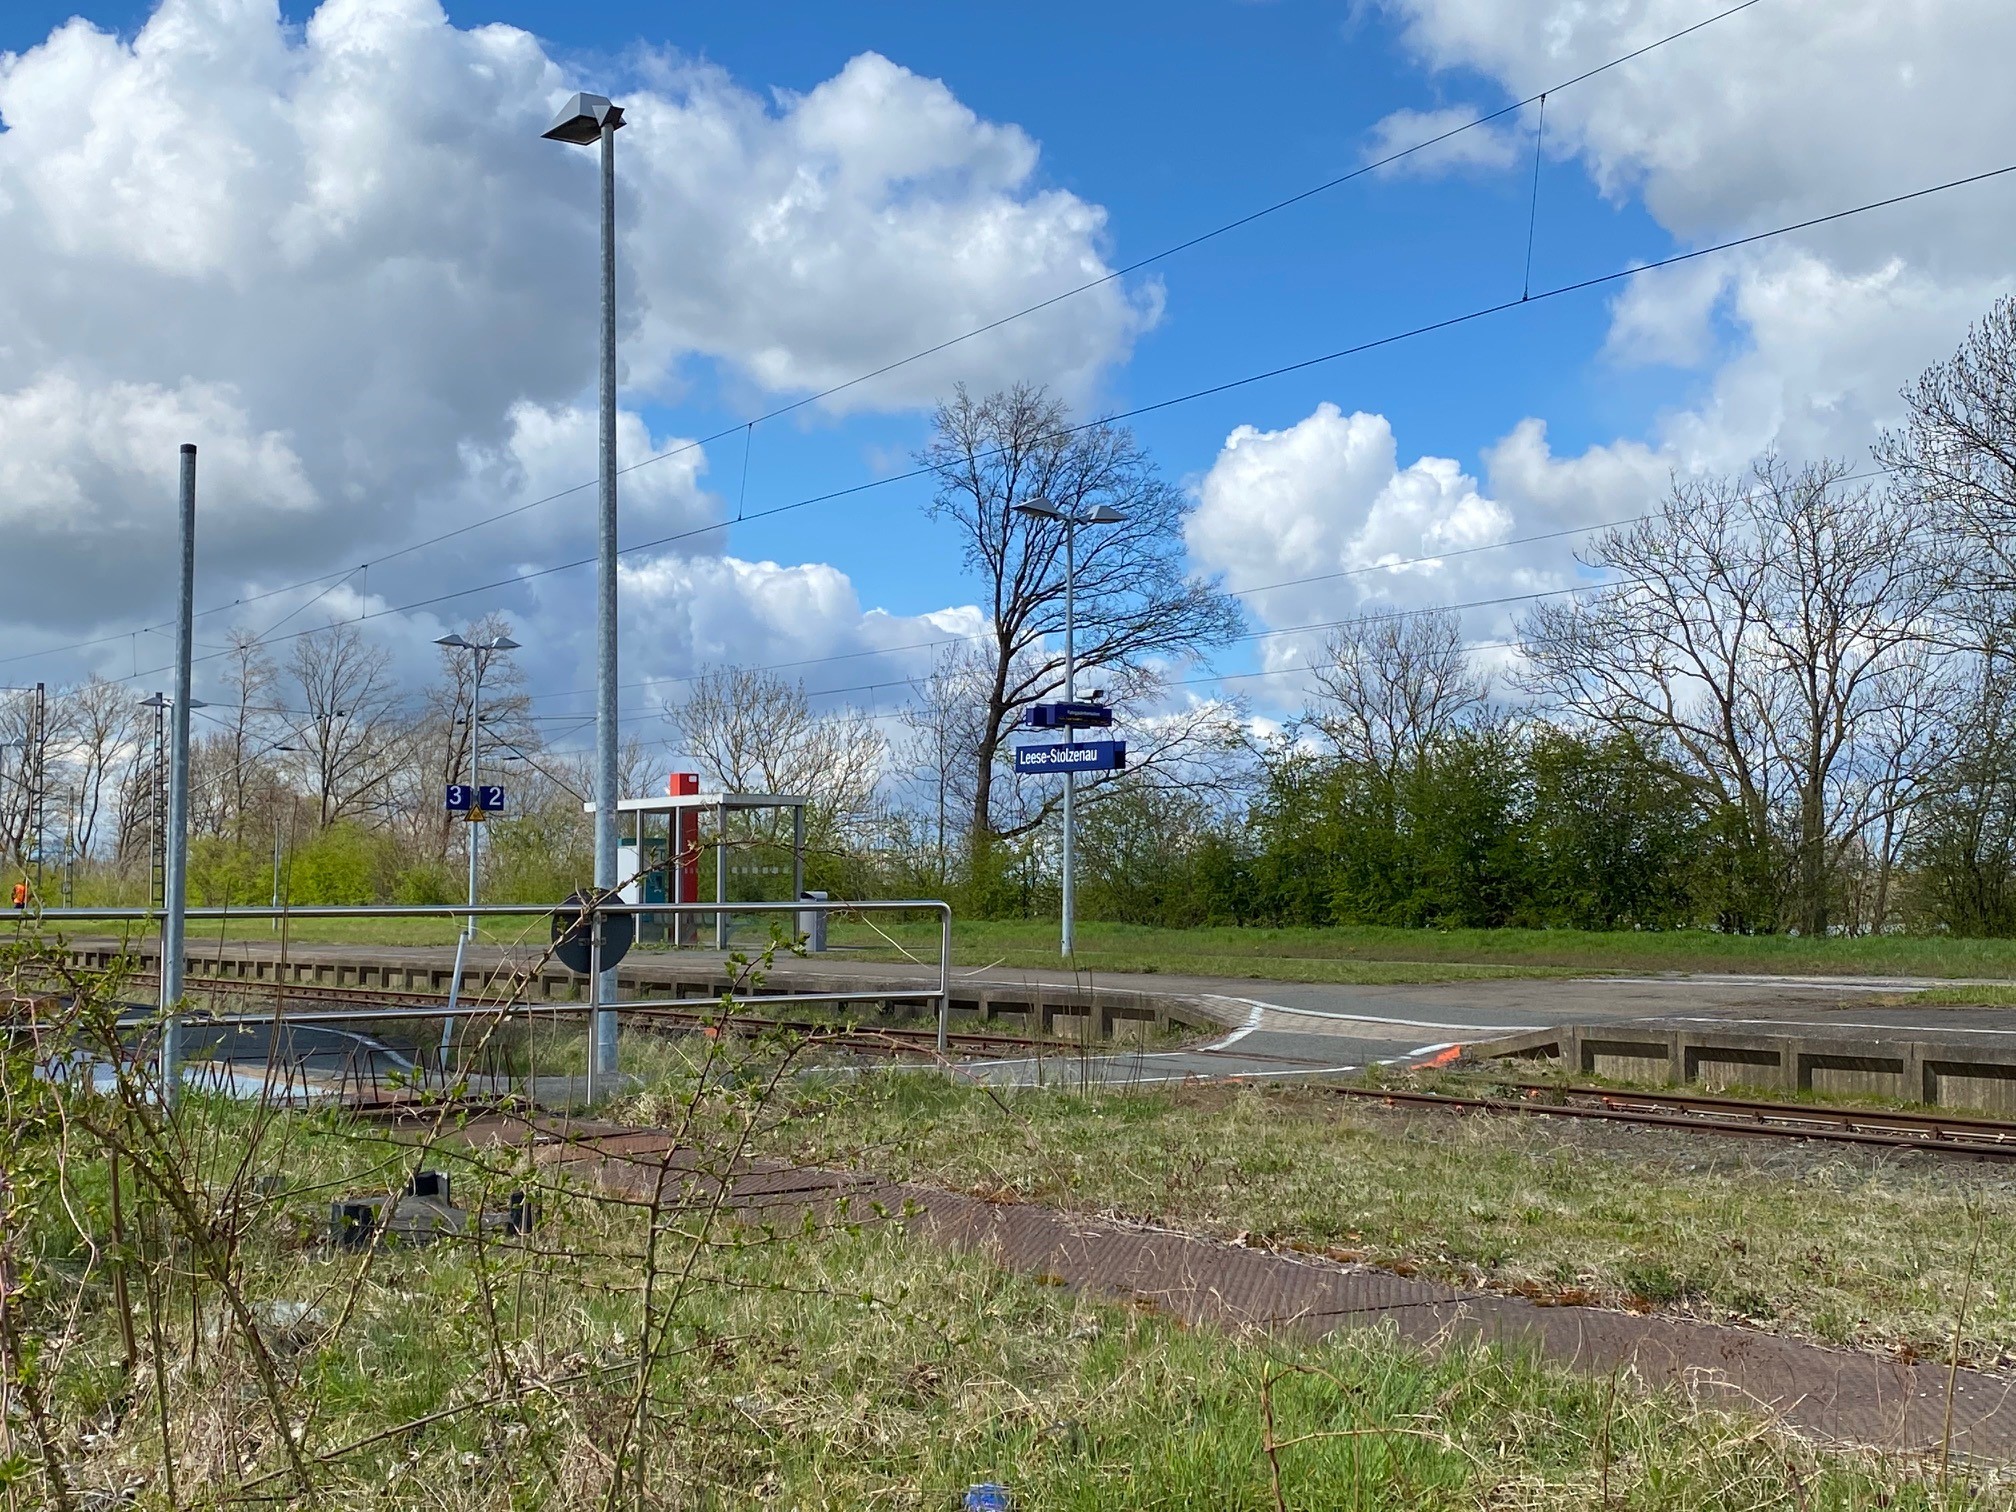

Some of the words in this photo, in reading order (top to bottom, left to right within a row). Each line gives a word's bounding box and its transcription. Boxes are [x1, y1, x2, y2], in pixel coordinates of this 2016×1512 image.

[1020, 748, 1097, 765] Leese-Stolzenau
[449, 785, 462, 805] 3
[489, 786, 501, 806] 2
